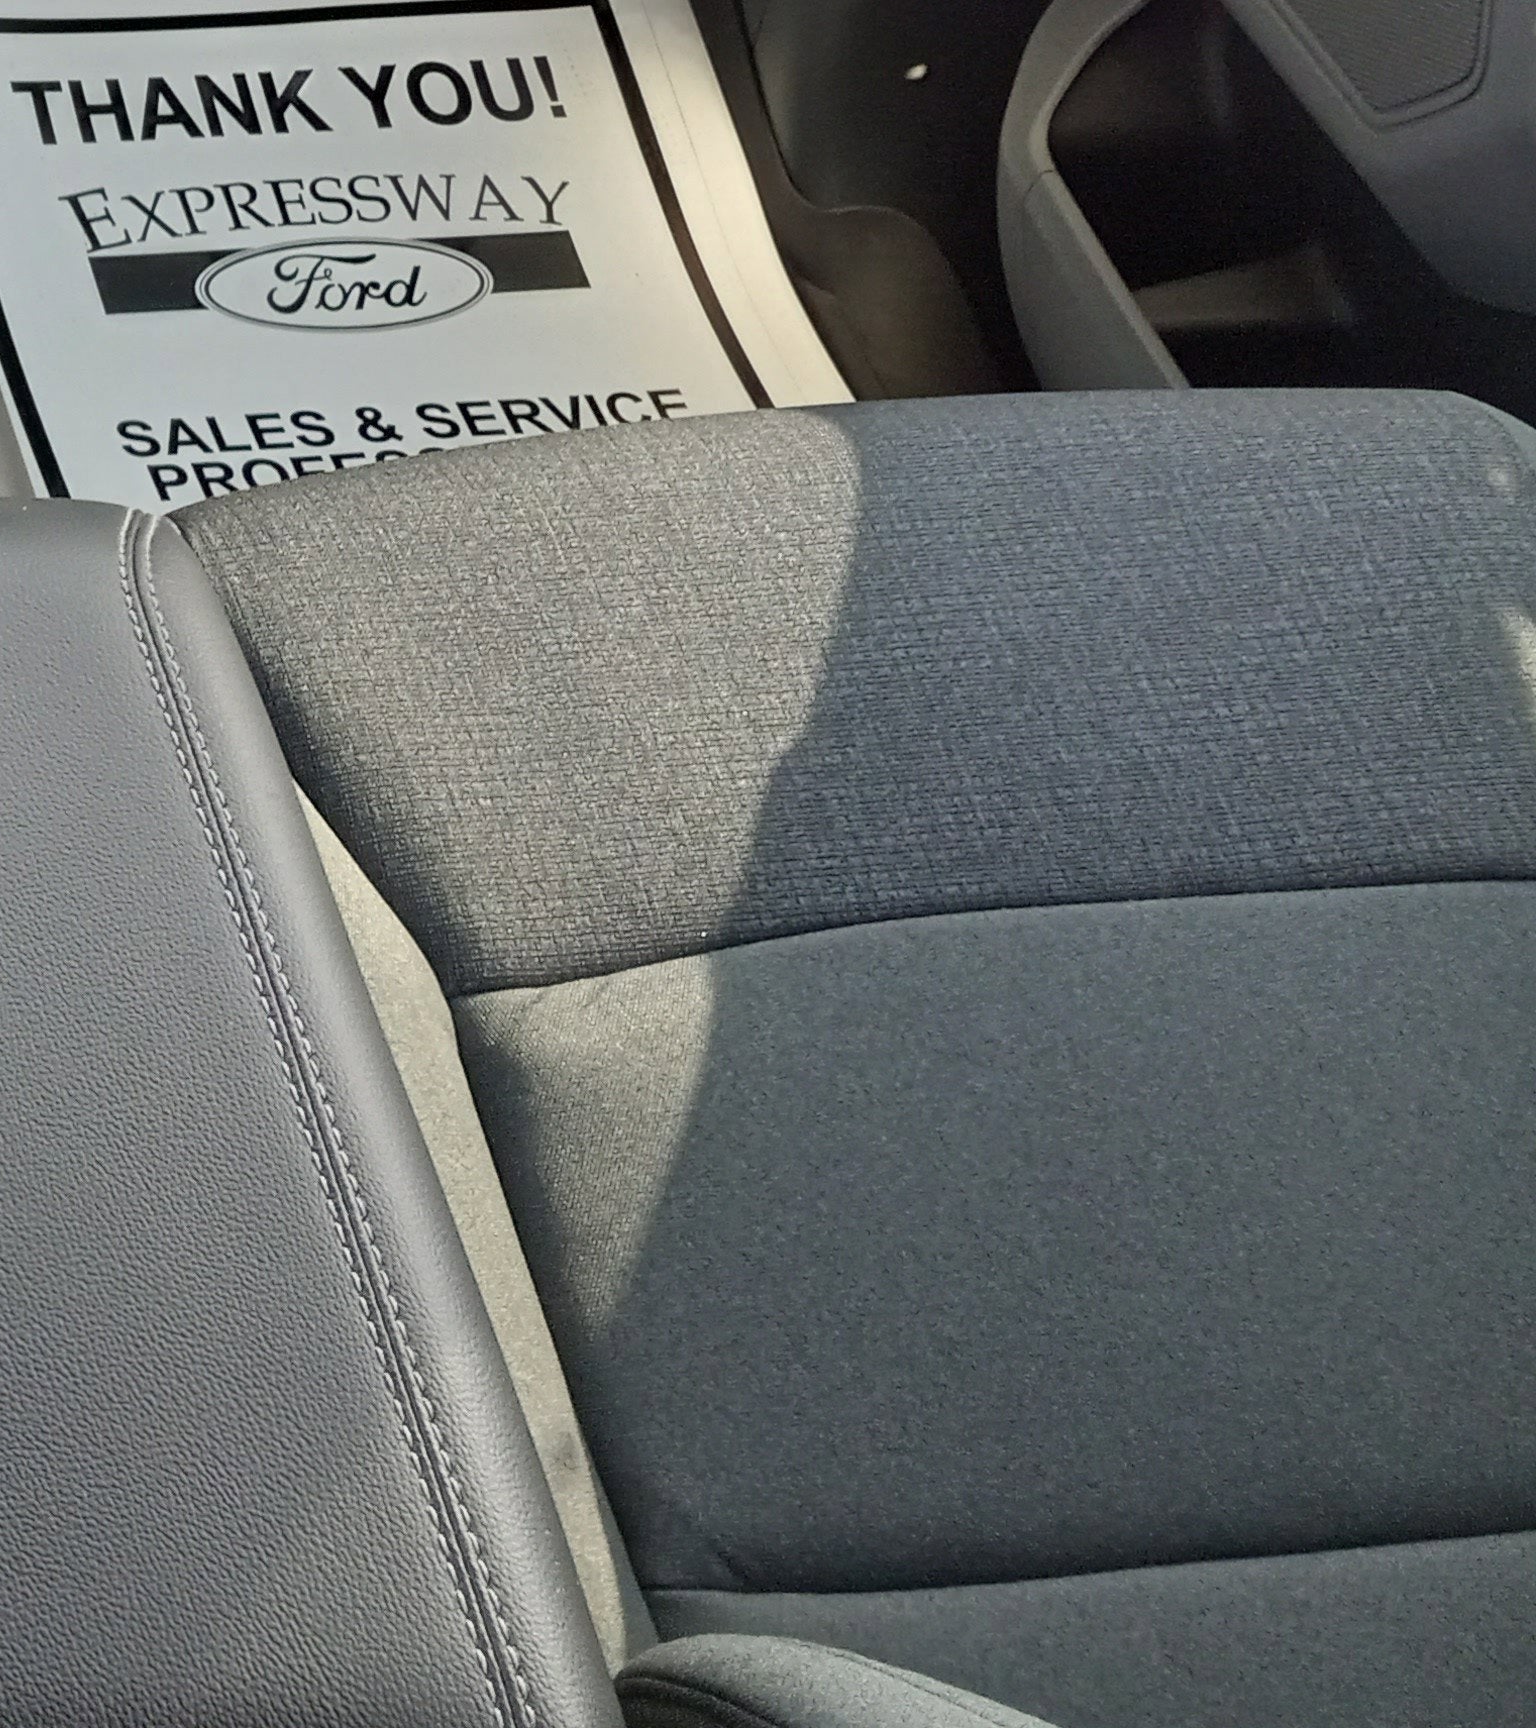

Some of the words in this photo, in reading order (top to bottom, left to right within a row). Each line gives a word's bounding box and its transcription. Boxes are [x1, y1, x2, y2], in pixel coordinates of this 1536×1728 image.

[11, 67, 333, 146] THANK
[338, 55, 567, 130] YOU!
[58, 173, 571, 254] EXPRESSWAY
[266, 253, 427, 315] Ford
[116, 410, 335, 458] SALES
[355, 406, 404, 443] &
